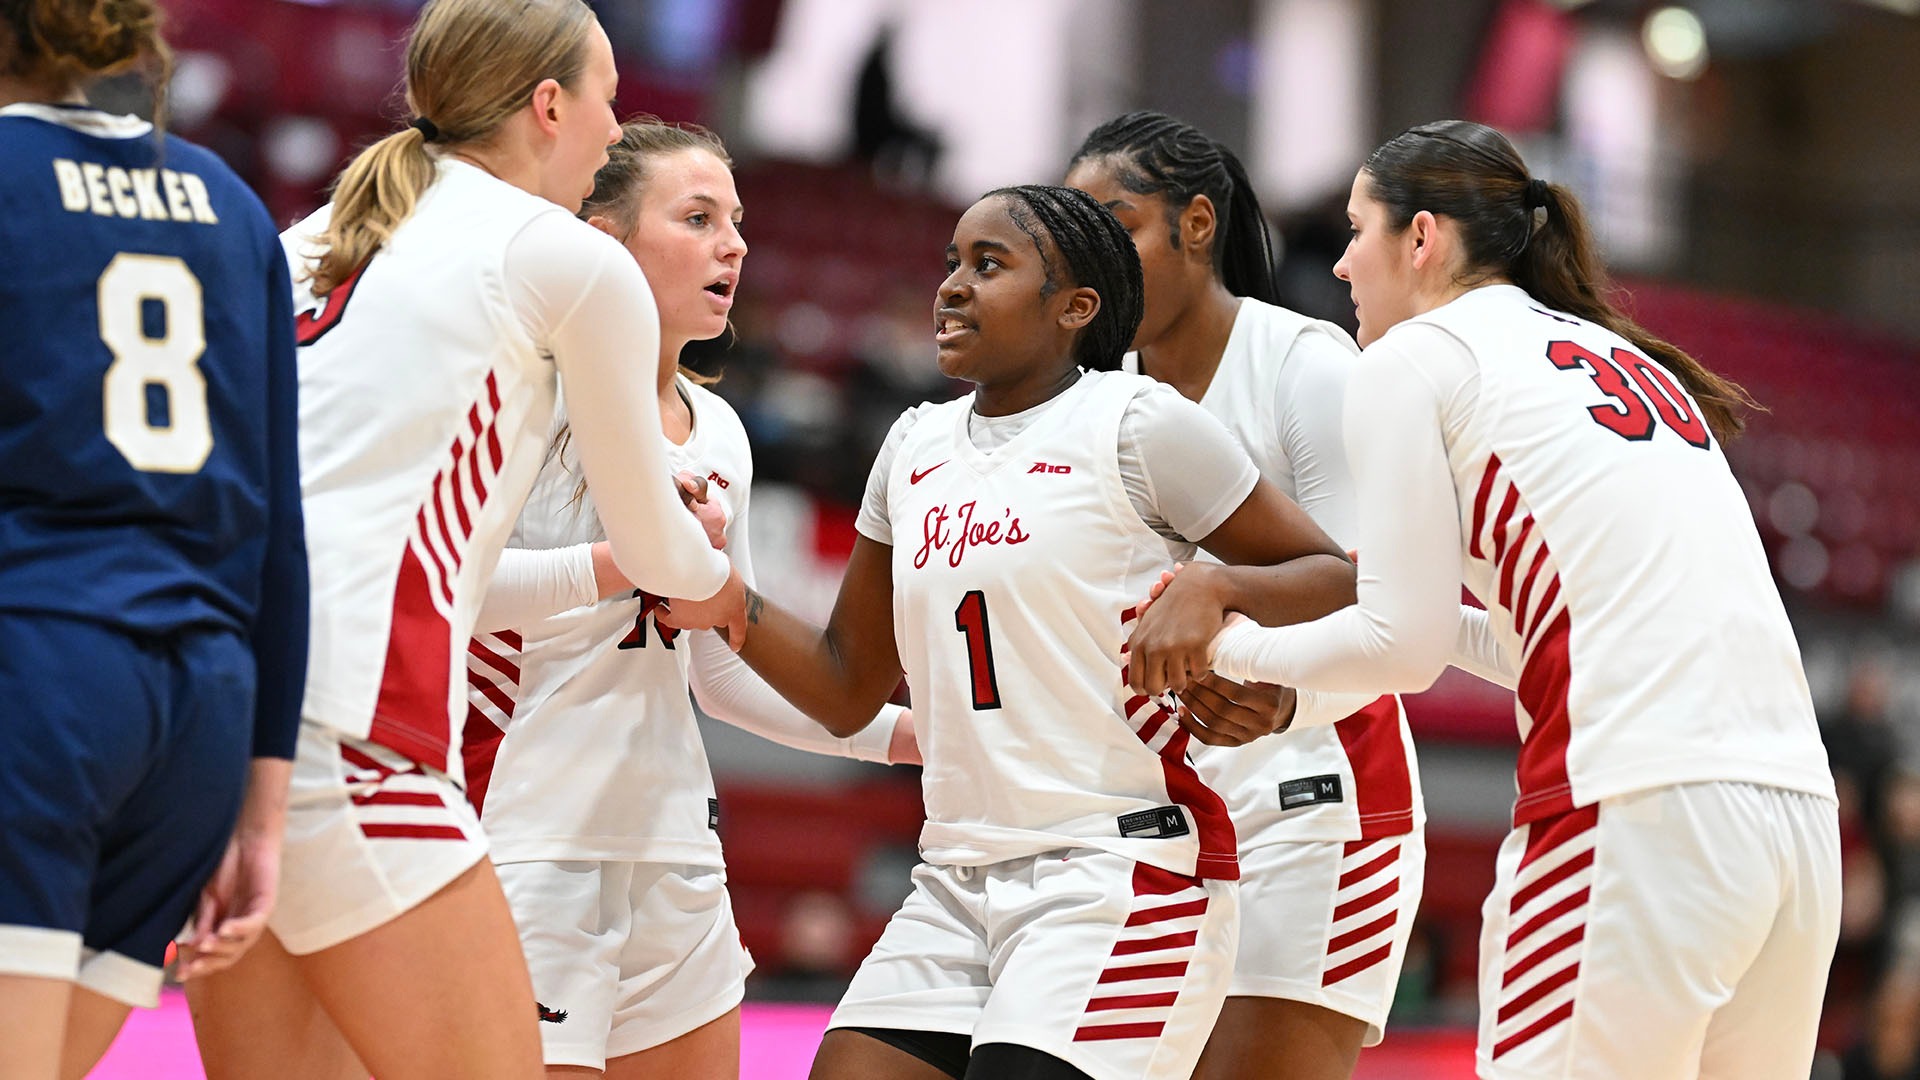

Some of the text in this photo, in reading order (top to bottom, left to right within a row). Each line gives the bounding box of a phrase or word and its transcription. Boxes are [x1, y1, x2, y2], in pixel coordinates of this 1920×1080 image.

[53, 158, 219, 225] BECKER
[97, 252, 214, 474] 8
[1546, 340, 1710, 451] 30
[1027, 462, 1071, 474] A10
[949, 501, 1030, 568] Joe's
[955, 590, 1002, 711] 1
[1166, 815, 1179, 828] M
[1320, 782, 1334, 794] M
